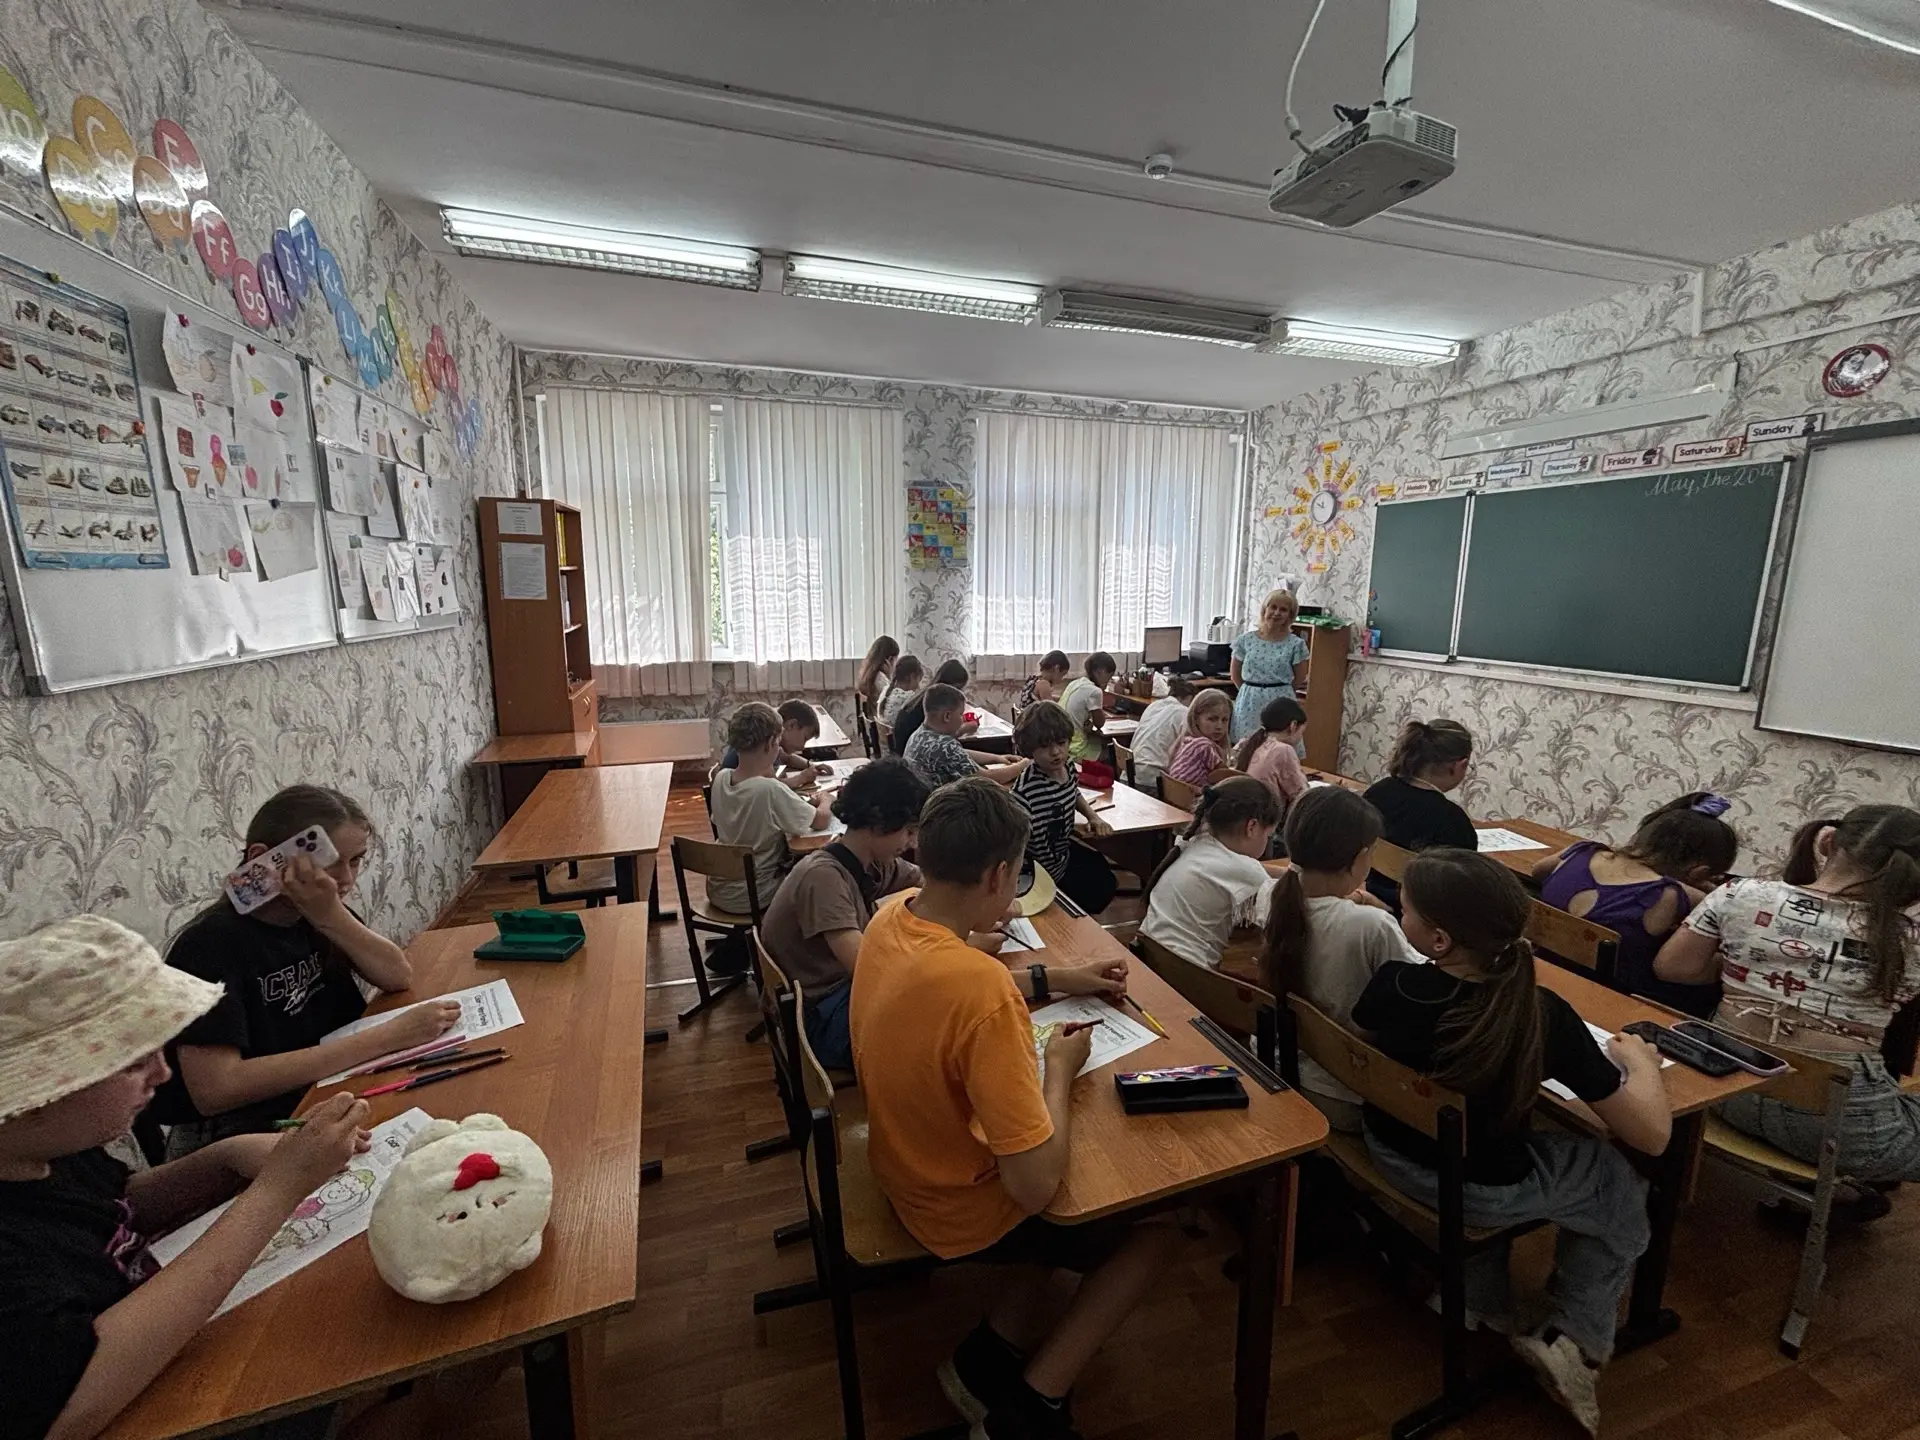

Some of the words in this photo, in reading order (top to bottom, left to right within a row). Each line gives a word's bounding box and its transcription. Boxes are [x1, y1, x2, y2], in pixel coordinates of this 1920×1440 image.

[201, 216, 230, 265] Ff
[301, 223, 315, 266] Jj
[262, 264, 292, 310] Hh
[320, 260, 342, 297] Kk
[239, 273, 267, 321] Gg
[379, 315, 395, 346] Oo
[1752, 424, 1794, 437] Sunday
[1607, 456, 1637, 467] Friday
[1679, 445, 1724, 457] Saturday
[1645, 474, 1699, 497] May,
[1702, 469, 1730, 488] the
